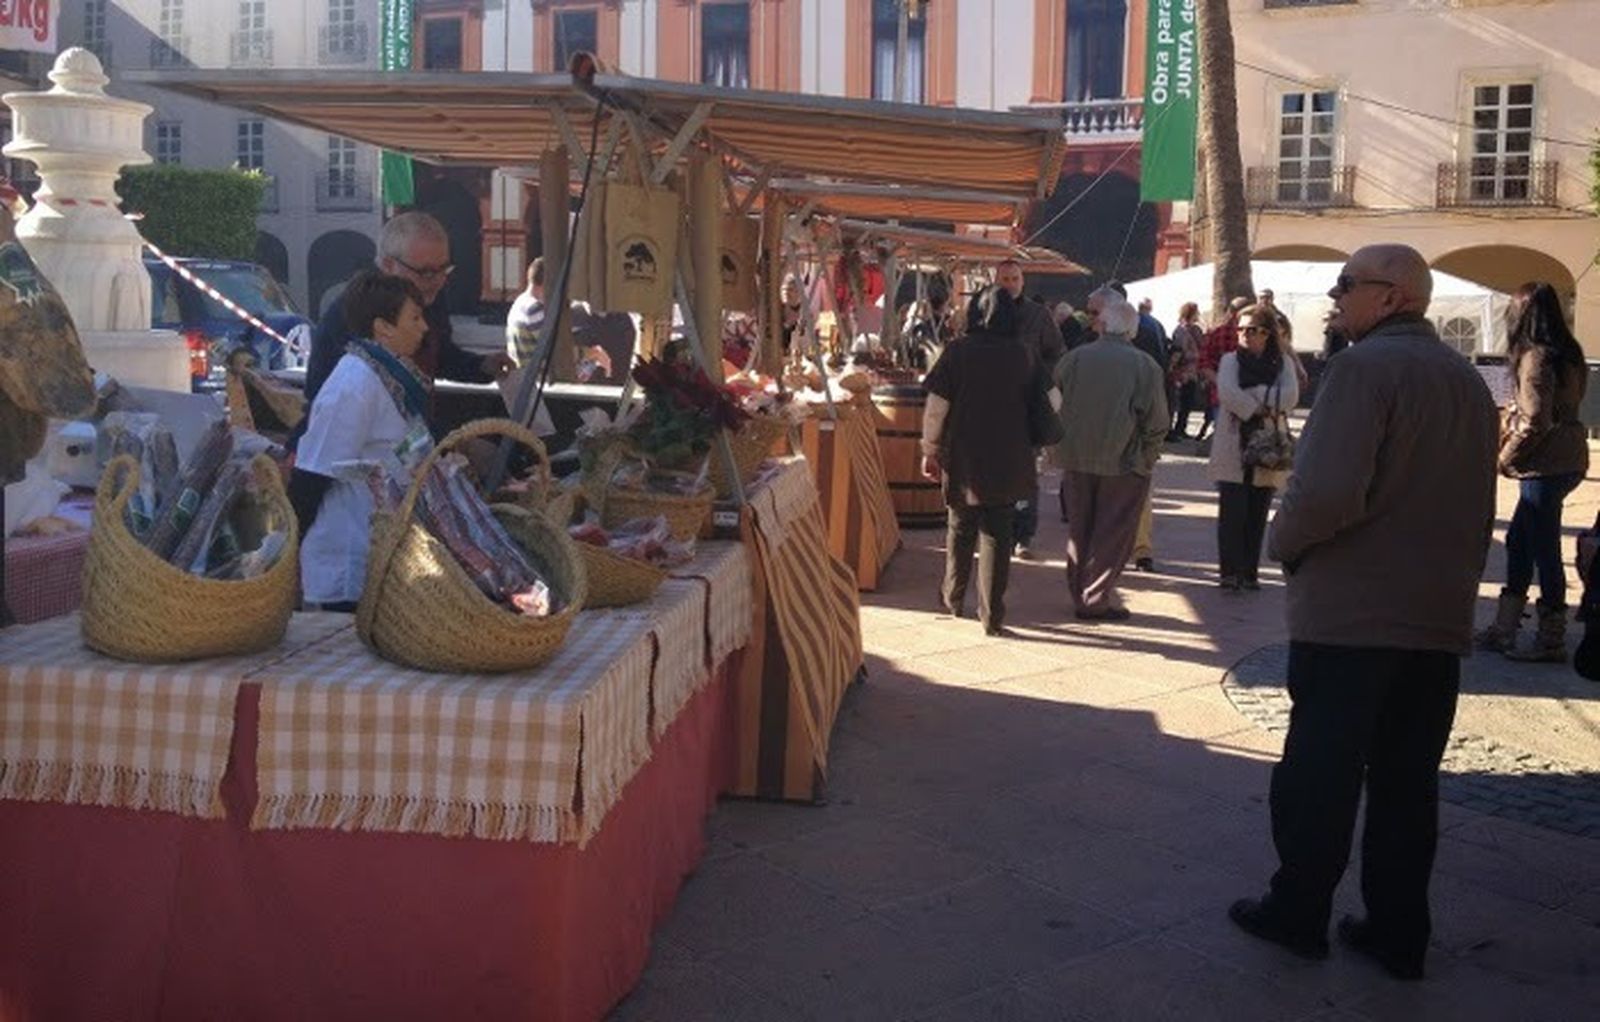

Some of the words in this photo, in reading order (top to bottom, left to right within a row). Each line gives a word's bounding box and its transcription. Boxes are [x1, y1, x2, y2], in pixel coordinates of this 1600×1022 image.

[1158, 0, 1175, 44] para
[1180, 0, 1194, 24] de
[1151, 51, 1169, 105] Obra
[1176, 29, 1194, 99] JUNTA
